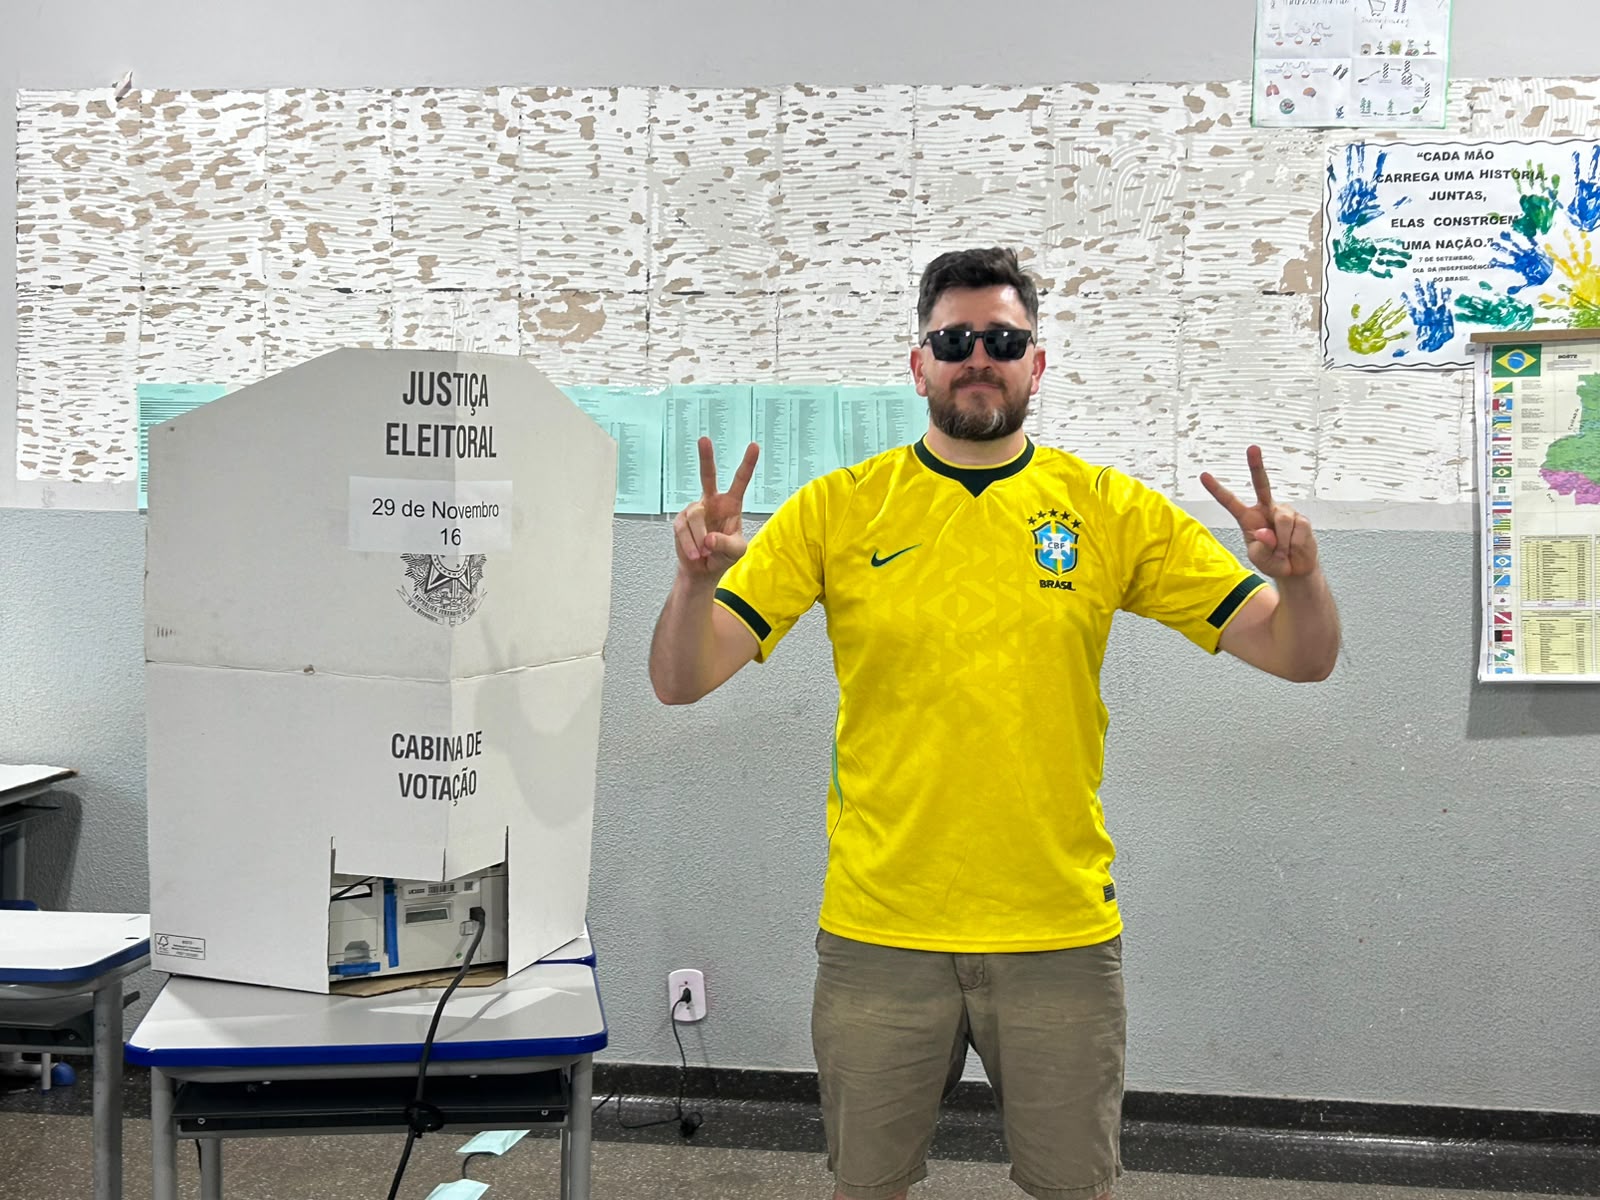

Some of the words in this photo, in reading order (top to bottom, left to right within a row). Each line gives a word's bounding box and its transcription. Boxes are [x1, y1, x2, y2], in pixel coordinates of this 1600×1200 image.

[1464, 148, 1494, 161] MÃO
[1375, 172, 1440, 184] CARREGA
[1444, 170, 1475, 181] UMA
[1428, 190, 1487, 203] JUNTAS,
[1390, 217, 1425, 229] ELAS
[1400, 240, 1432, 251] UMA
[402, 371, 489, 416] JUSTIÇA
[385, 422, 497, 459] ELEITORAL
[371, 497, 396, 516] 29
[401, 499, 426, 518] de
[431, 500, 500, 520] Novembro
[439, 527, 462, 546] 16
[1047, 541, 1066, 550] CBF
[1039, 579, 1077, 592] BRASIL
[391, 732, 464, 762] CABINA
[466, 730, 483, 758] DE
[398, 766, 478, 807] VOTAÇÃO
